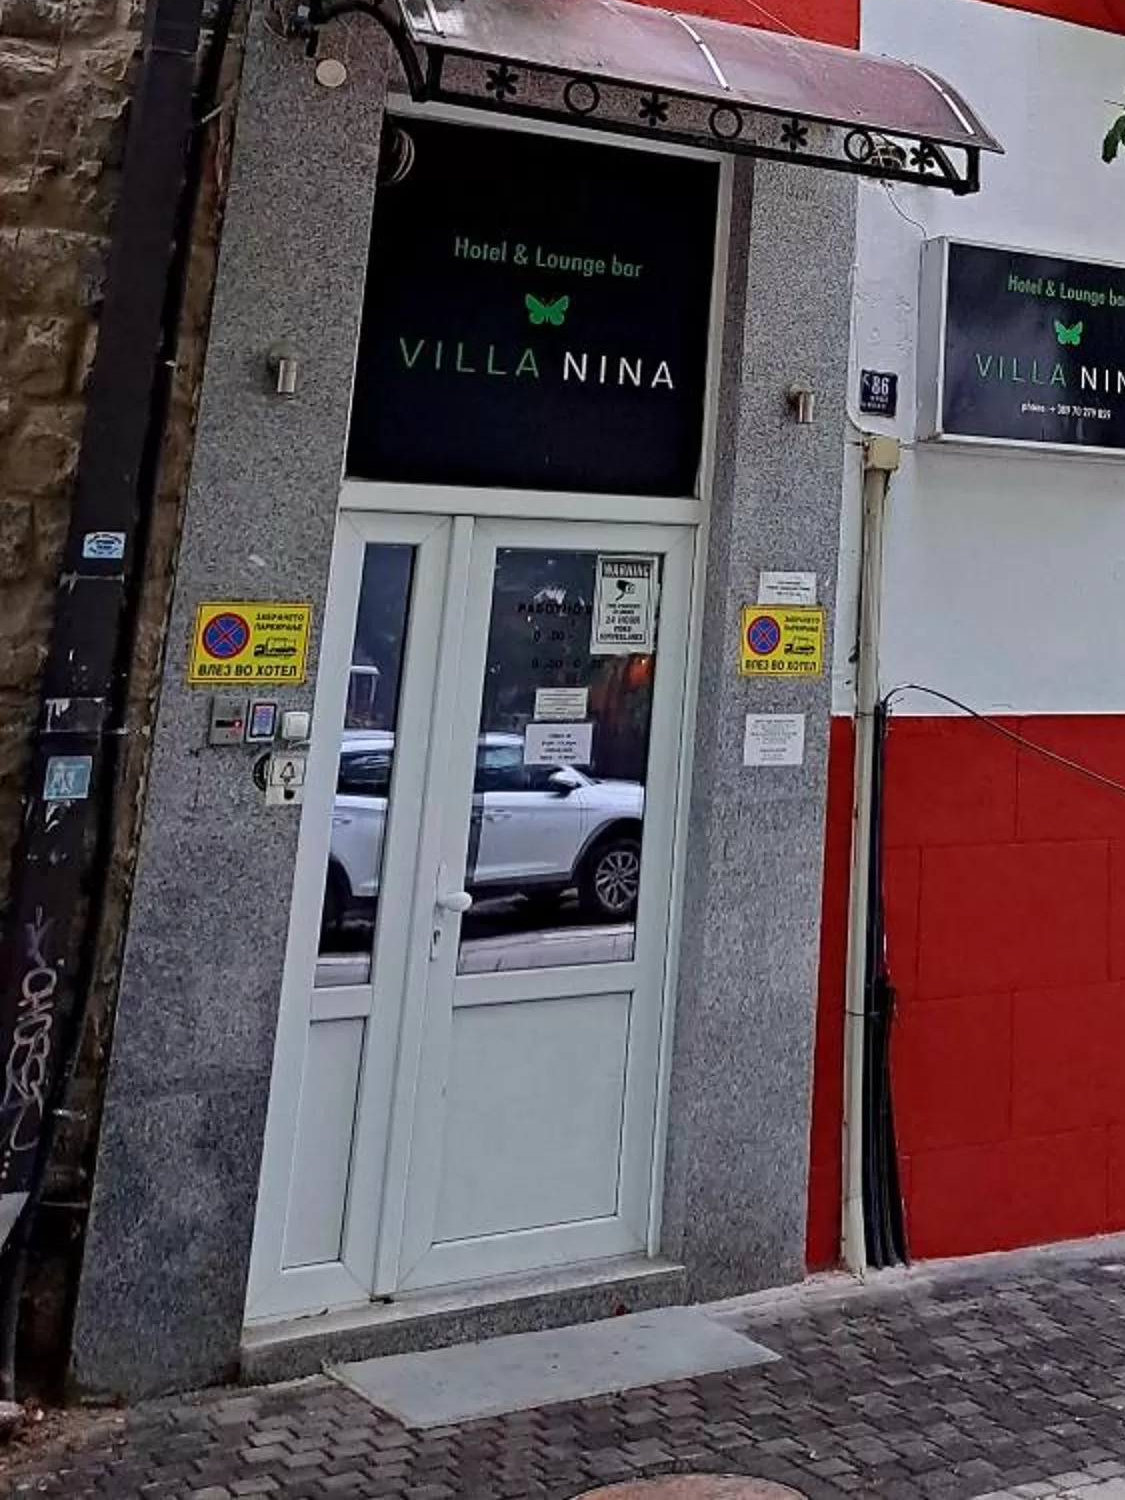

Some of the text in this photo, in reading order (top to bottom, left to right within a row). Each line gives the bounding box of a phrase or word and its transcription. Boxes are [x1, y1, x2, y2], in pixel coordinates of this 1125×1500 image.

[455, 236, 643, 277] Hotel & Lounge bar
[1008, 274, 1043, 295] Hotel
[1045, 280, 1056, 297] &
[1060, 282, 1105, 307] Lounge
[400, 338, 674, 389] VILLA NINA
[976, 354, 1066, 388] VILLA
[871, 375, 890, 396] 86
[198, 664, 297, 676] ВЛЕЗ ВО ХОТЕЛ
